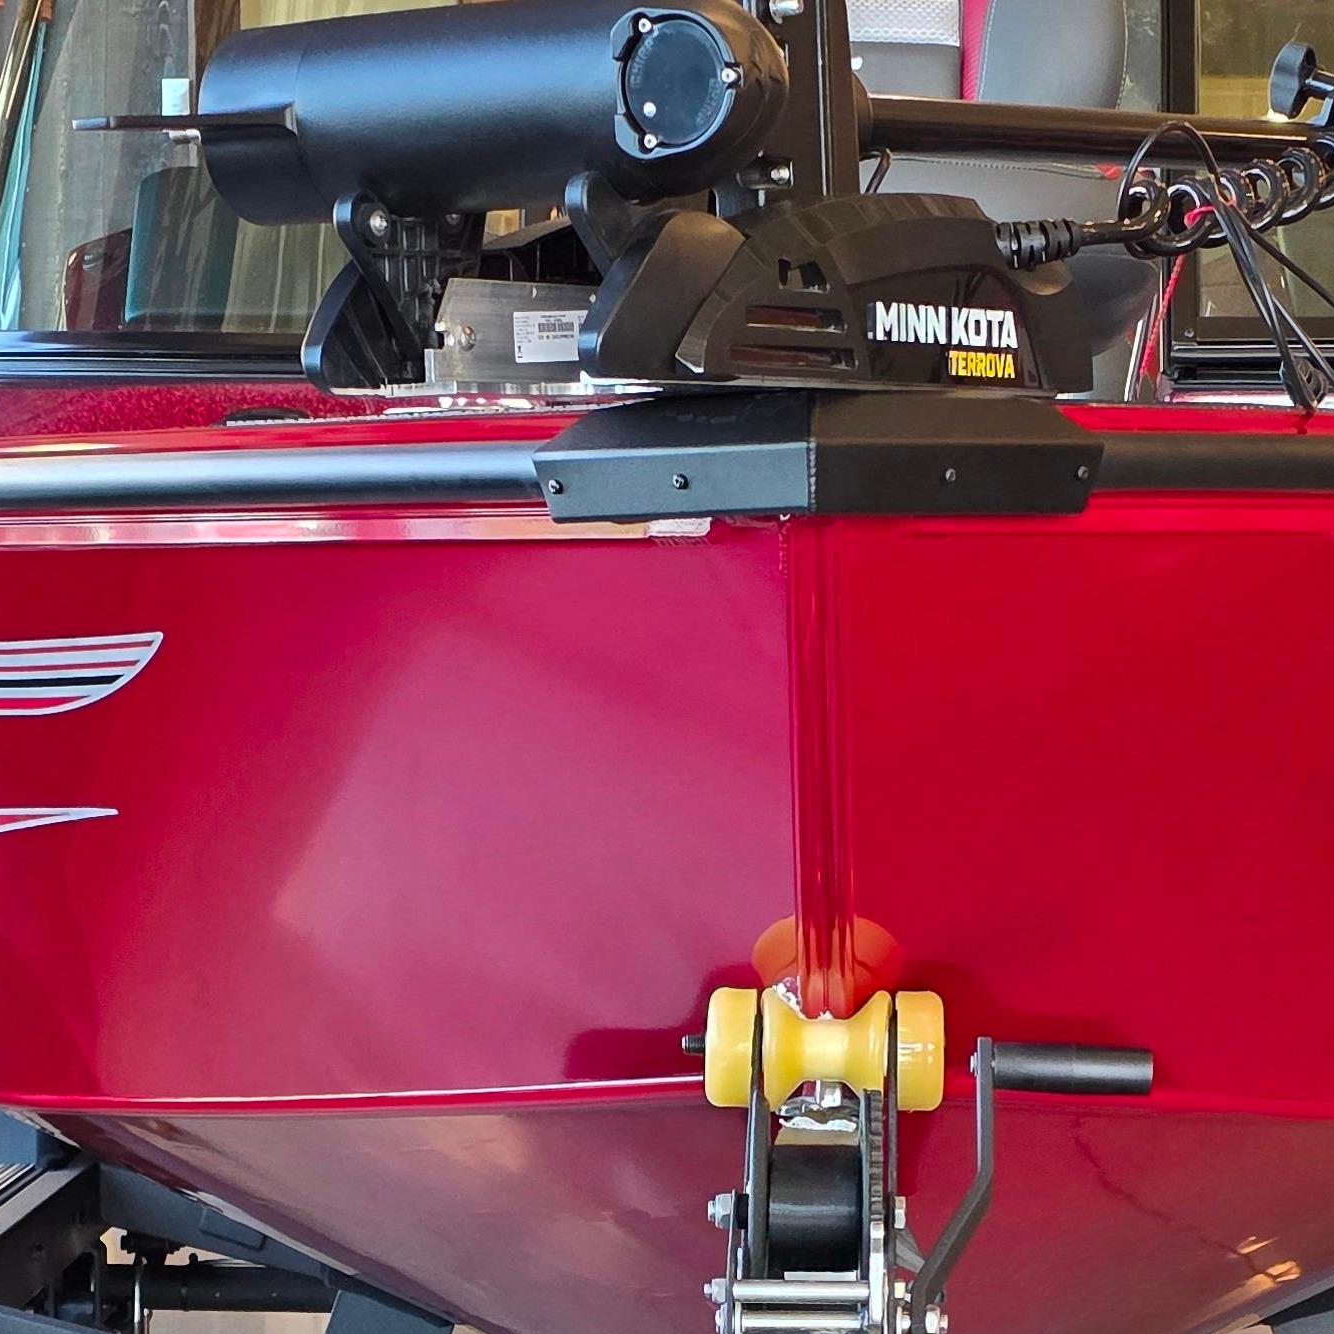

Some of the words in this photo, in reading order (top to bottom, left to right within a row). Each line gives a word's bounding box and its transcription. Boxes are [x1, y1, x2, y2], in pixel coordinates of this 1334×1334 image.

[875, 301, 947, 345] MINN
[951, 306, 1019, 349] KOTA
[948, 350, 1016, 379] TERROVA
